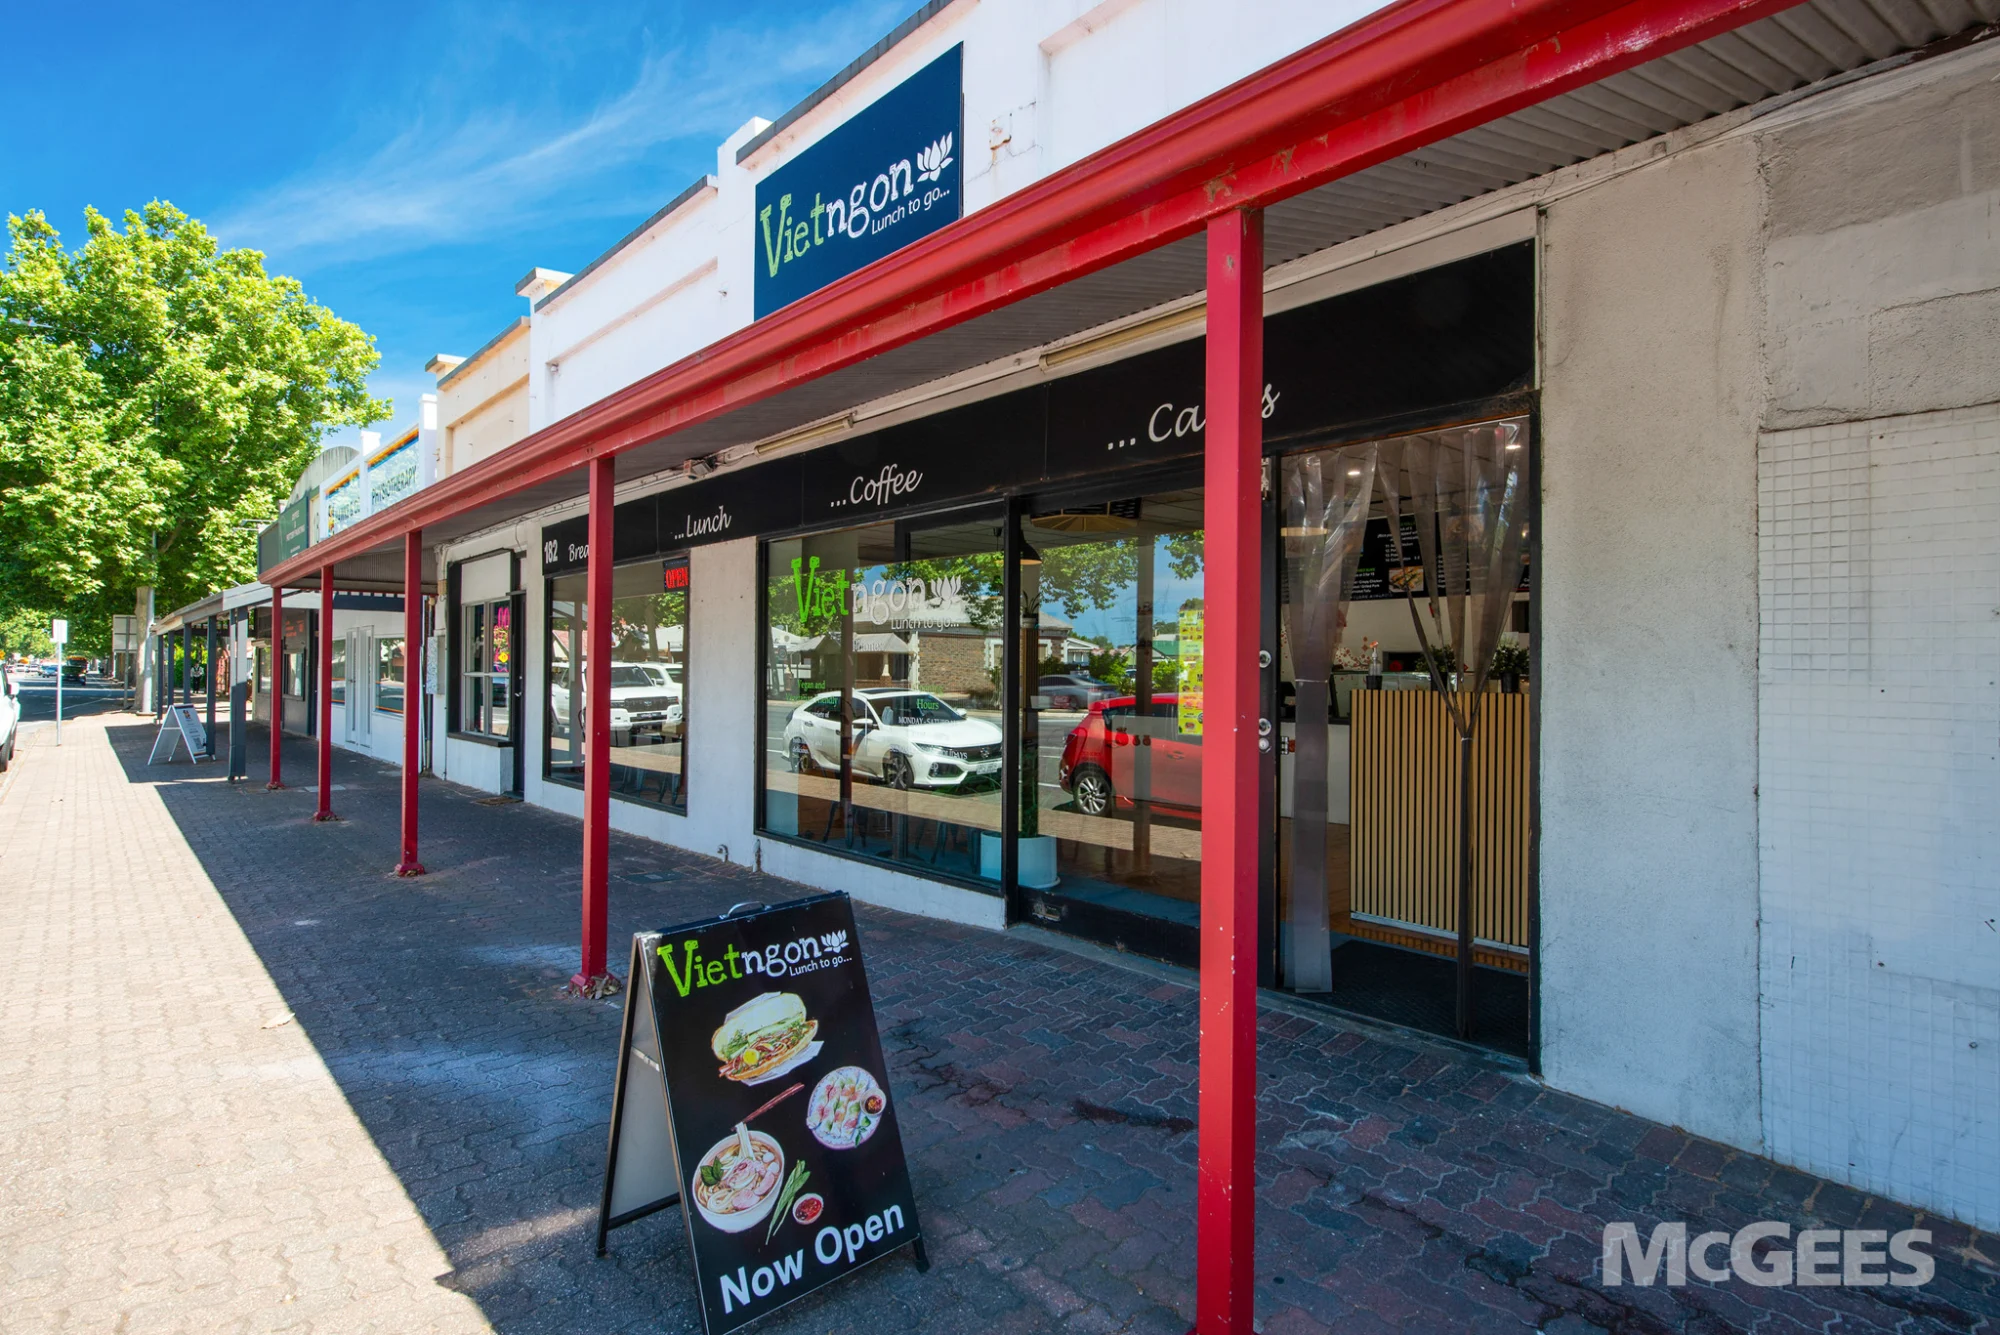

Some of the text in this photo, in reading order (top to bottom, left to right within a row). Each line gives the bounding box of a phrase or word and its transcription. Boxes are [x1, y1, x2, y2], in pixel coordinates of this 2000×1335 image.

[760, 158, 914, 278] Vietngon
[871, 187, 950, 235] Lunch to go...
[1148, 383, 1281, 443] Cas
[544, 539, 589, 564] 182 Brea
[665, 566, 689, 589] OPEN
[891, 616, 920, 630] Lunch
[923, 617, 934, 629] to
[916, 698, 940, 710] Hours
[898, 716, 924, 725] MONDAY
[657, 935, 822, 997] Vietngon
[789, 960, 818, 977] Lunch
[820, 959, 830, 968] to
[719, 1204, 905, 1313] Now Open
